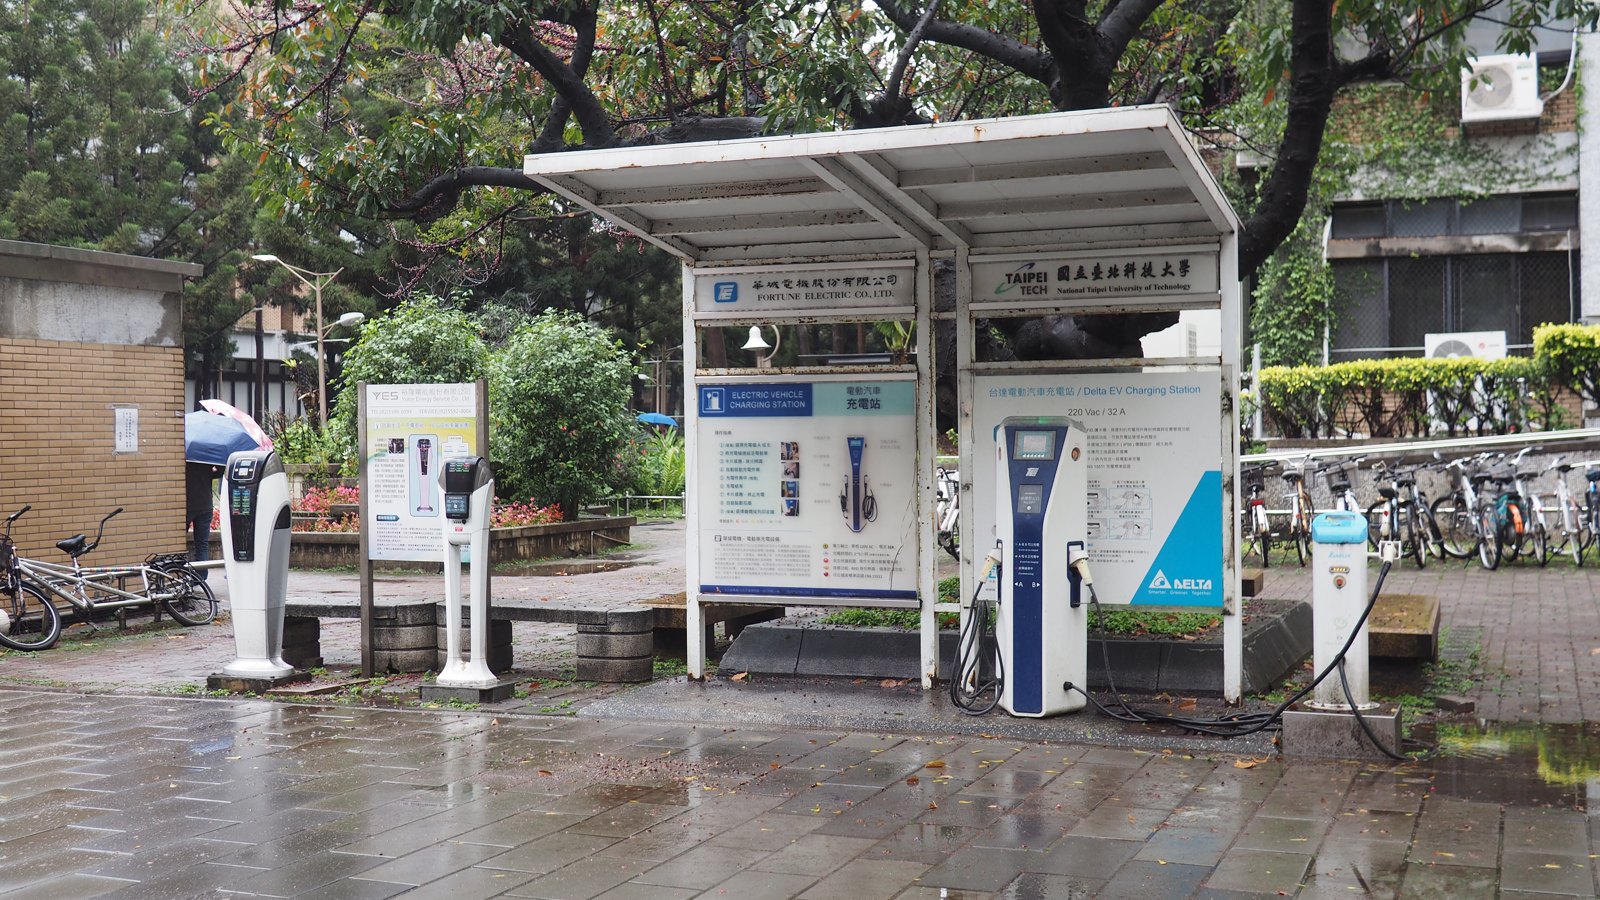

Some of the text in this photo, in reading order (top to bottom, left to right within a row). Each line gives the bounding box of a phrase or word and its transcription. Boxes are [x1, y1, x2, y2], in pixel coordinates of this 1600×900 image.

[1057, 258, 1191, 282] 國立臺北科技大學
[752, 274, 898, 290] 華城電機股份有限公司
[1006, 272, 1048, 284] TAIPEI
[1020, 285, 1048, 295] TECH
[1057, 286, 1085, 294] National
[1086, 285, 1107, 294] Taipei
[1108, 284, 1143, 294] University
[1153, 282, 1191, 292] Technology
[758, 292, 800, 302] FORTUNE
[805, 291, 851, 300] ELECTRIC
[874, 289, 894, 298] LTD.
[372, 392, 398, 400] YES
[770, 391, 804, 399] VEHICLE
[846, 386, 881, 395] 電動汽車
[988, 386, 1074, 397] 台達電動汽車充電站
[1084, 386, 1107, 396] Delta
[1109, 386, 1122, 395] EV
[1125, 386, 1166, 397] Charging
[1169, 385, 1200, 394] Station
[730, 400, 806, 409] CHARGING STATION
[846, 398, 881, 410] 充電站
[1068, 408, 1083, 416] 220
[1174, 579, 1212, 590] DELTA
